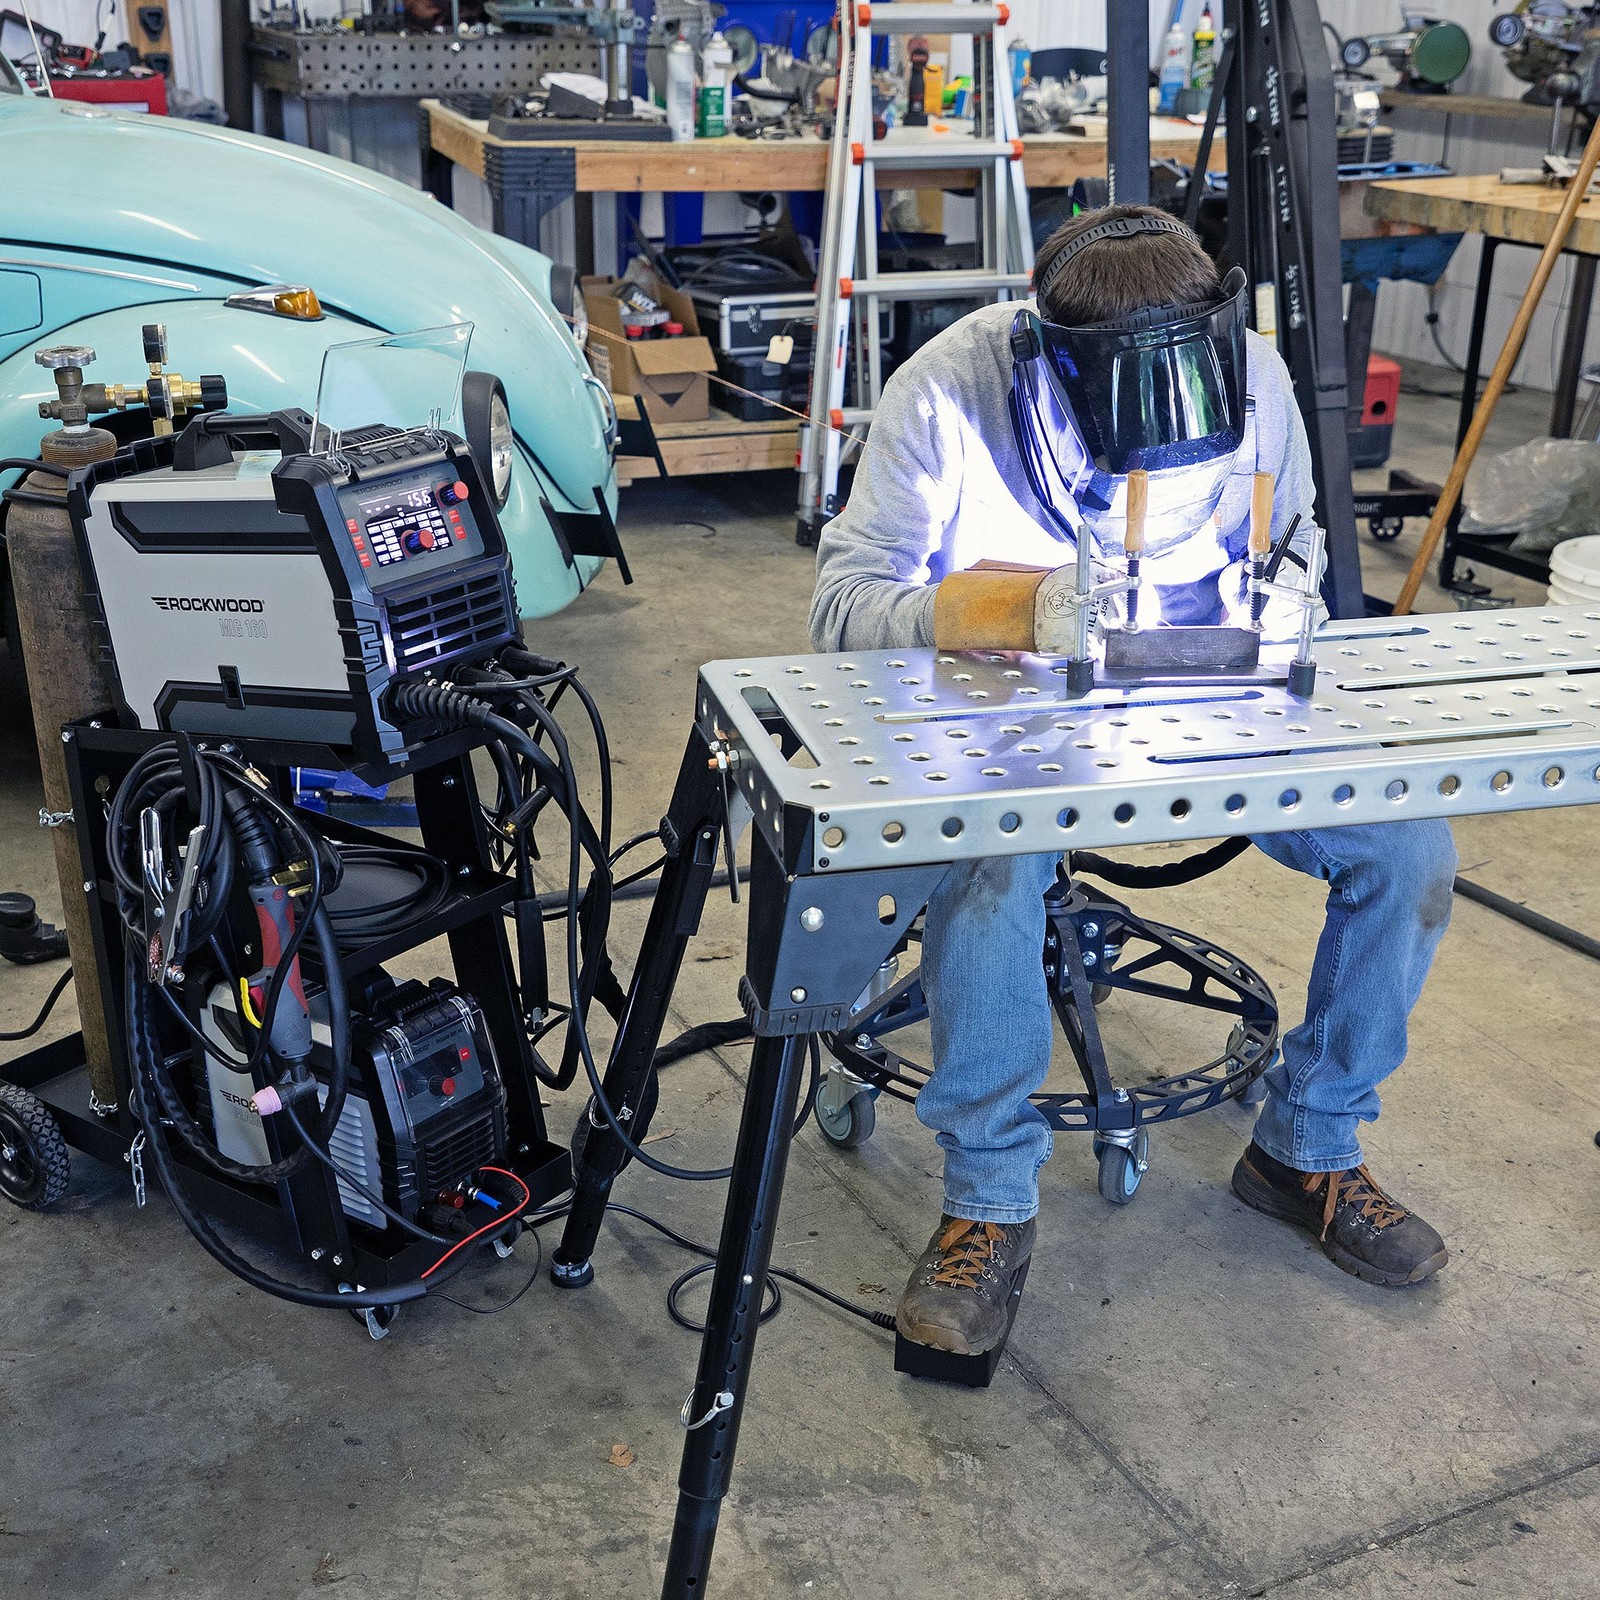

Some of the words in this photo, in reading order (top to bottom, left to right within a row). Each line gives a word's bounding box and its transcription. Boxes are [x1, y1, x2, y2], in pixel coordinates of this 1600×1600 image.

[167, 597, 264, 613] ROCKWOOD
[219, 618, 243, 638] MIG
[245, 619, 269, 639] 160
